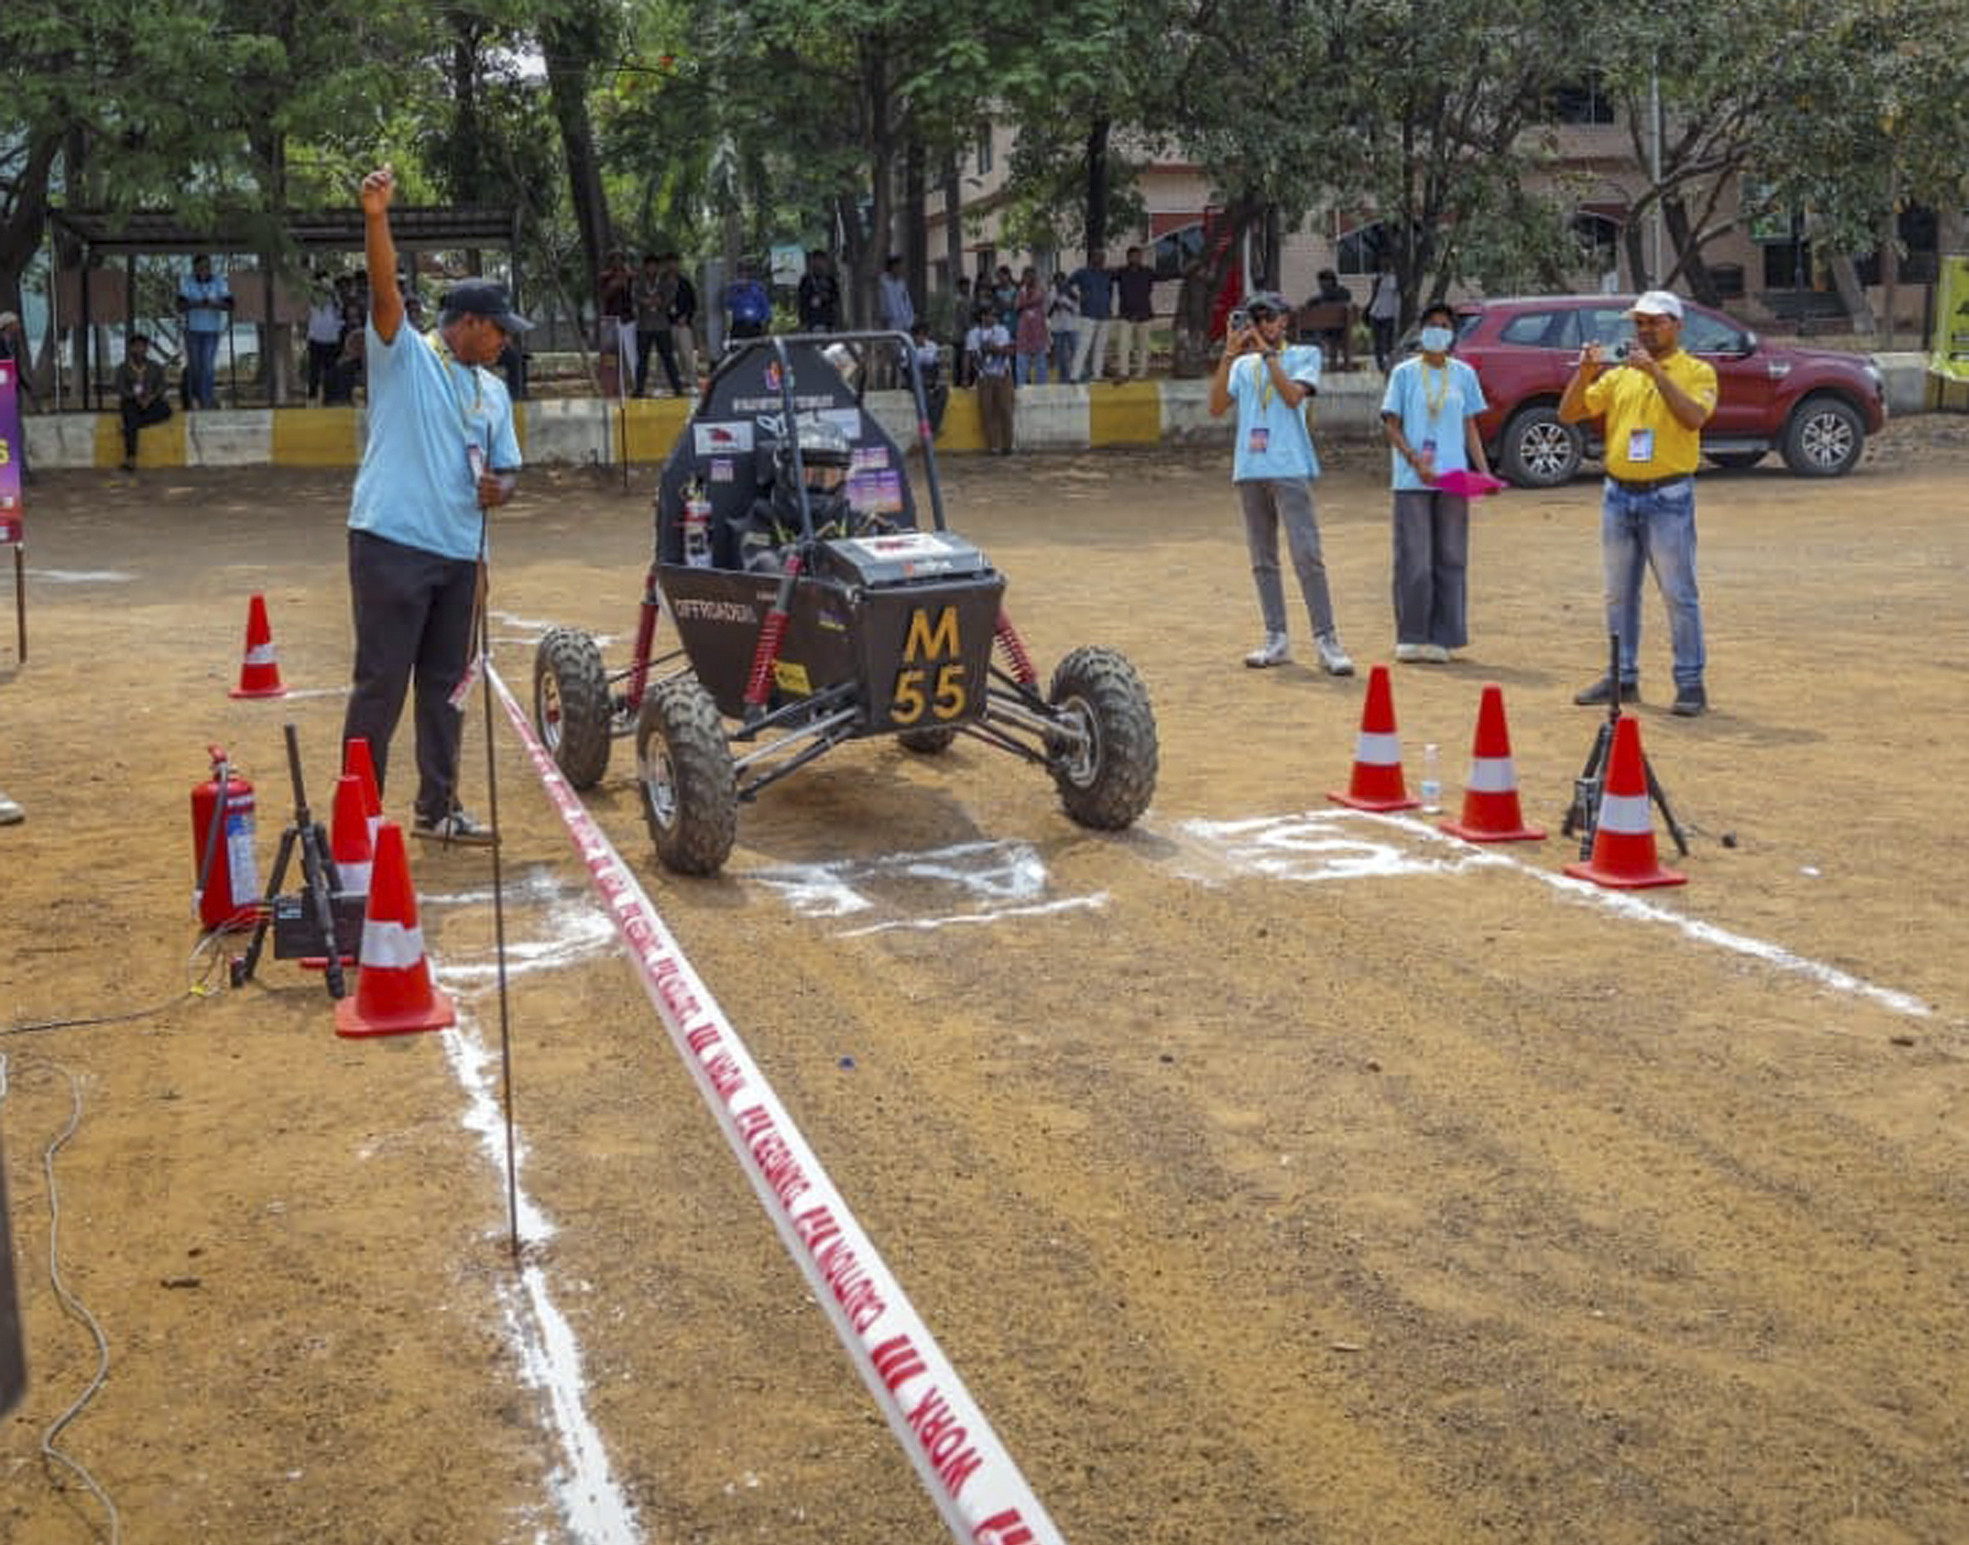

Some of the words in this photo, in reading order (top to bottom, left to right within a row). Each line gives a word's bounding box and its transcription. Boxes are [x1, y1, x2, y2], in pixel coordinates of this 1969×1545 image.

[903, 605, 960, 662] M
[890, 665, 966, 723] 55
[817, 1238, 887, 1334] CAUTION
[906, 1386, 984, 1499] WORK
